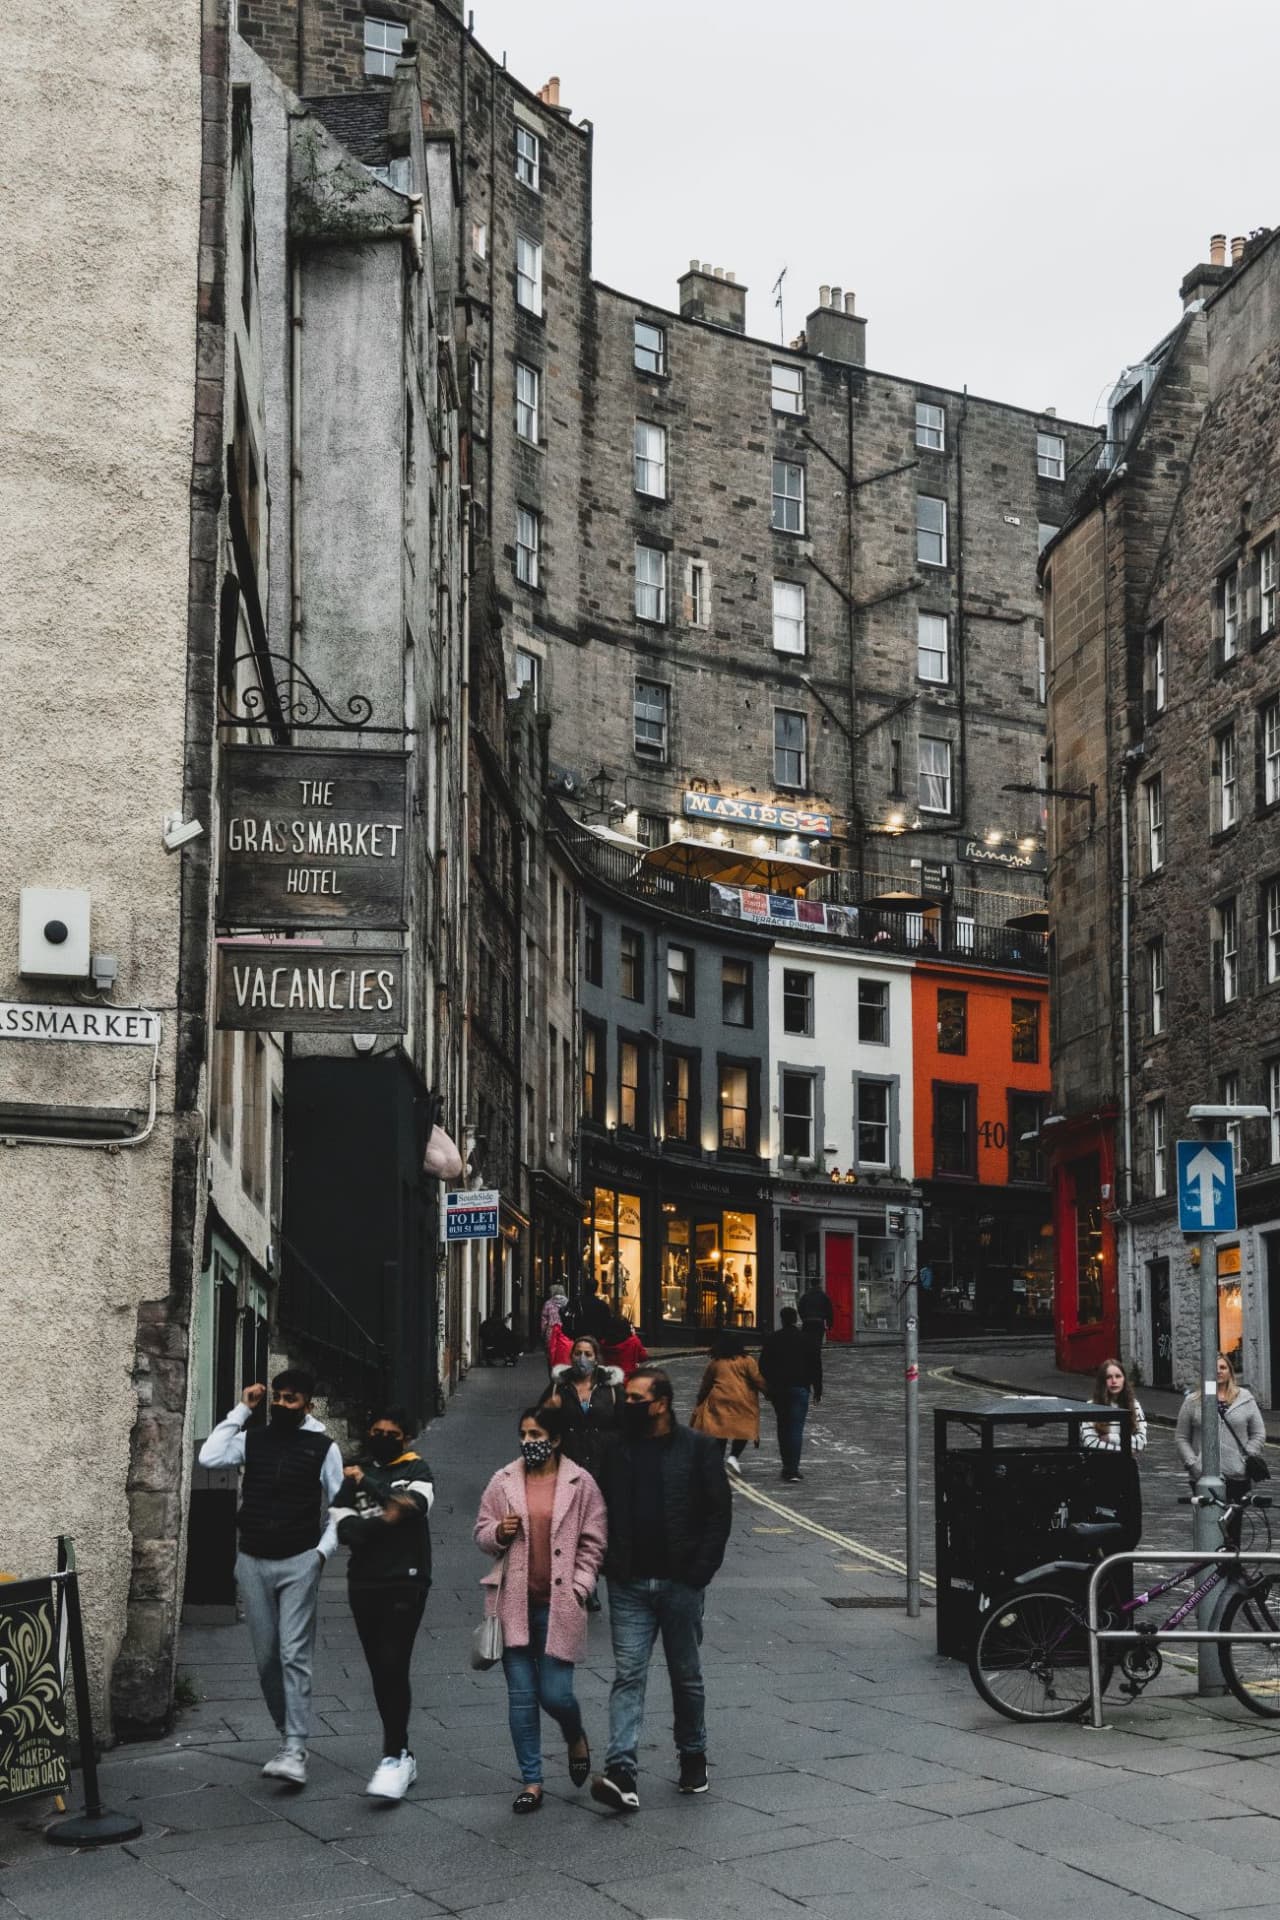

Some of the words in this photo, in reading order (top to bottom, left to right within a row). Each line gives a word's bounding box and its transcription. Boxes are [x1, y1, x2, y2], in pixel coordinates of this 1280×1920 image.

[299, 781, 335, 806] THE
[690, 795, 798, 827] MAXIES
[229, 818, 403, 857] GRASSMARKET
[287, 868, 342, 894] HOTEL
[752, 915, 786, 925] TERRACE
[789, 920, 815, 930] DINING
[232, 966, 394, 1010] VACANCIES
[0, 1009, 153, 1039] SSMARKET
[977, 1121, 1006, 1149] 40
[449, 1213, 467, 1225] TO
[471, 1212, 496, 1223] LET
[19, 1747, 51, 1767] NAKED
[10, 1766, 40, 1793] GOLDEN
[41, 1754, 66, 1785] OATS
